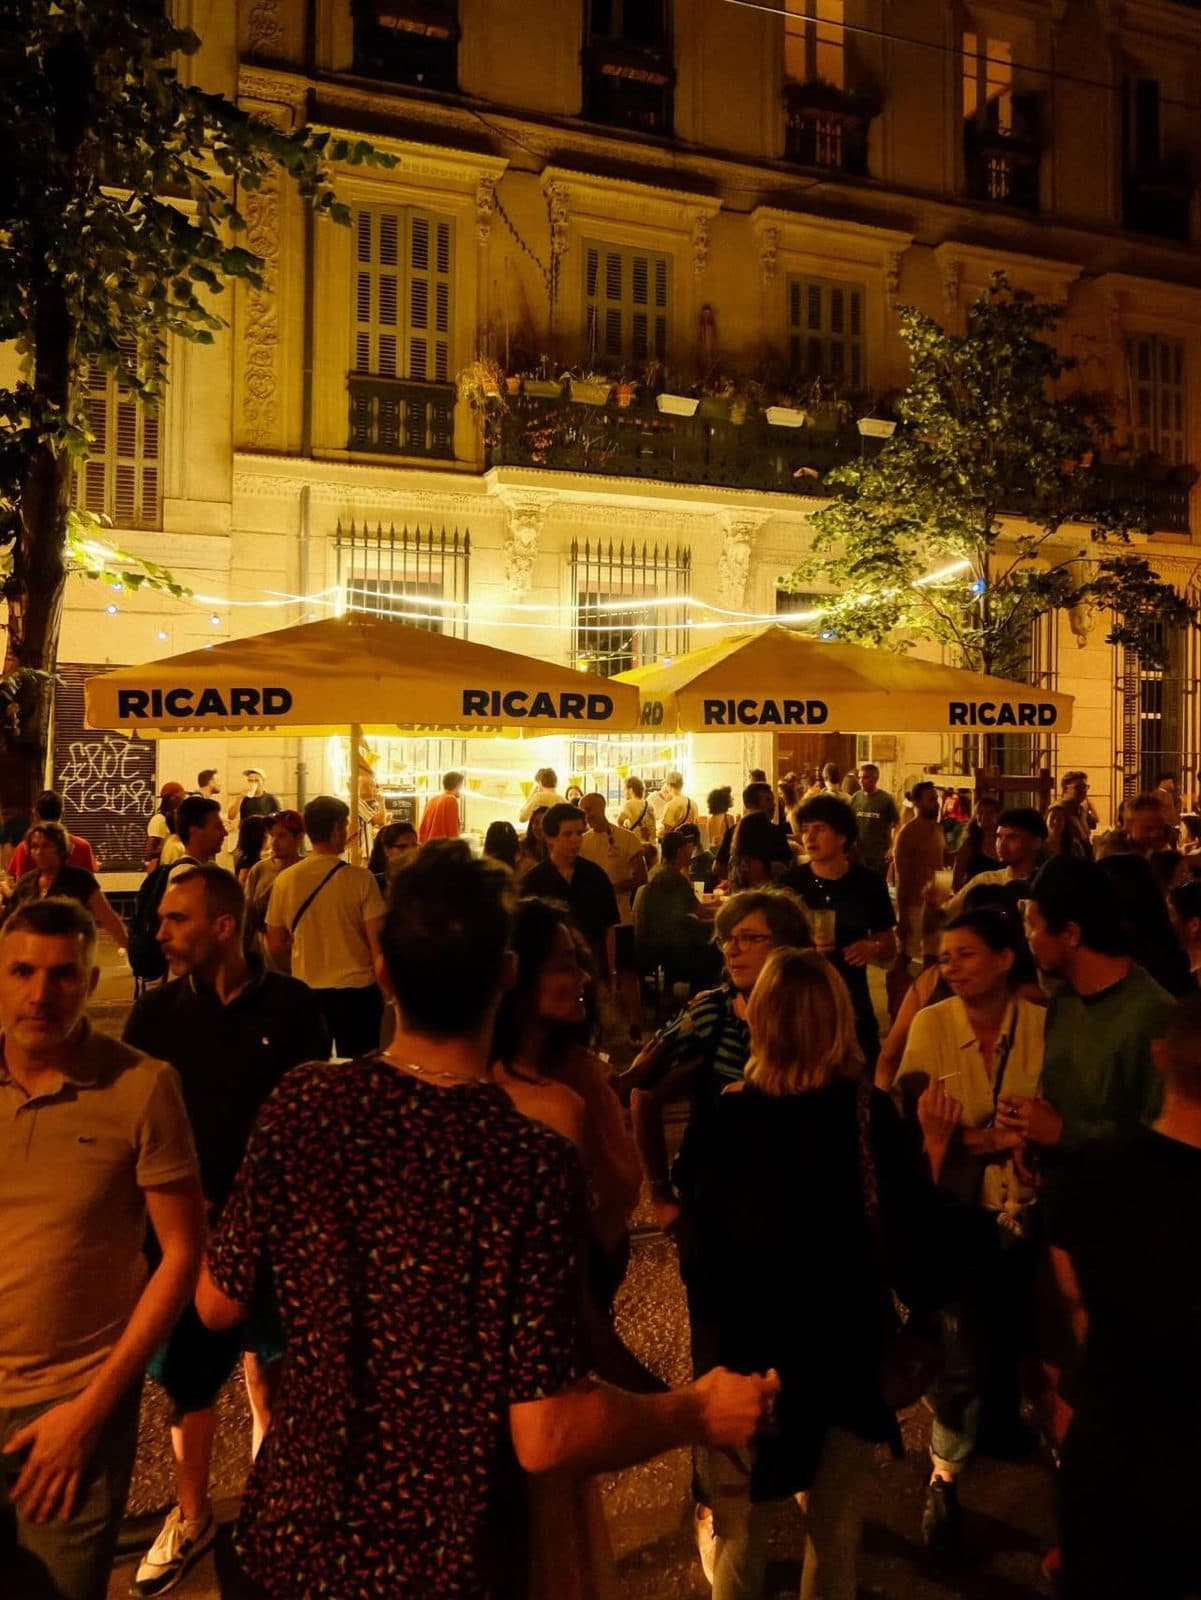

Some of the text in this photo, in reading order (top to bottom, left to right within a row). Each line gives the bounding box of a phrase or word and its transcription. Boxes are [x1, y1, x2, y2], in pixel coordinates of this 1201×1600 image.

[118, 688, 293, 718] RICARD
[462, 689, 613, 720] RICARD
[703, 699, 828, 726] RICARD
[949, 701, 1057, 726] RICARD
